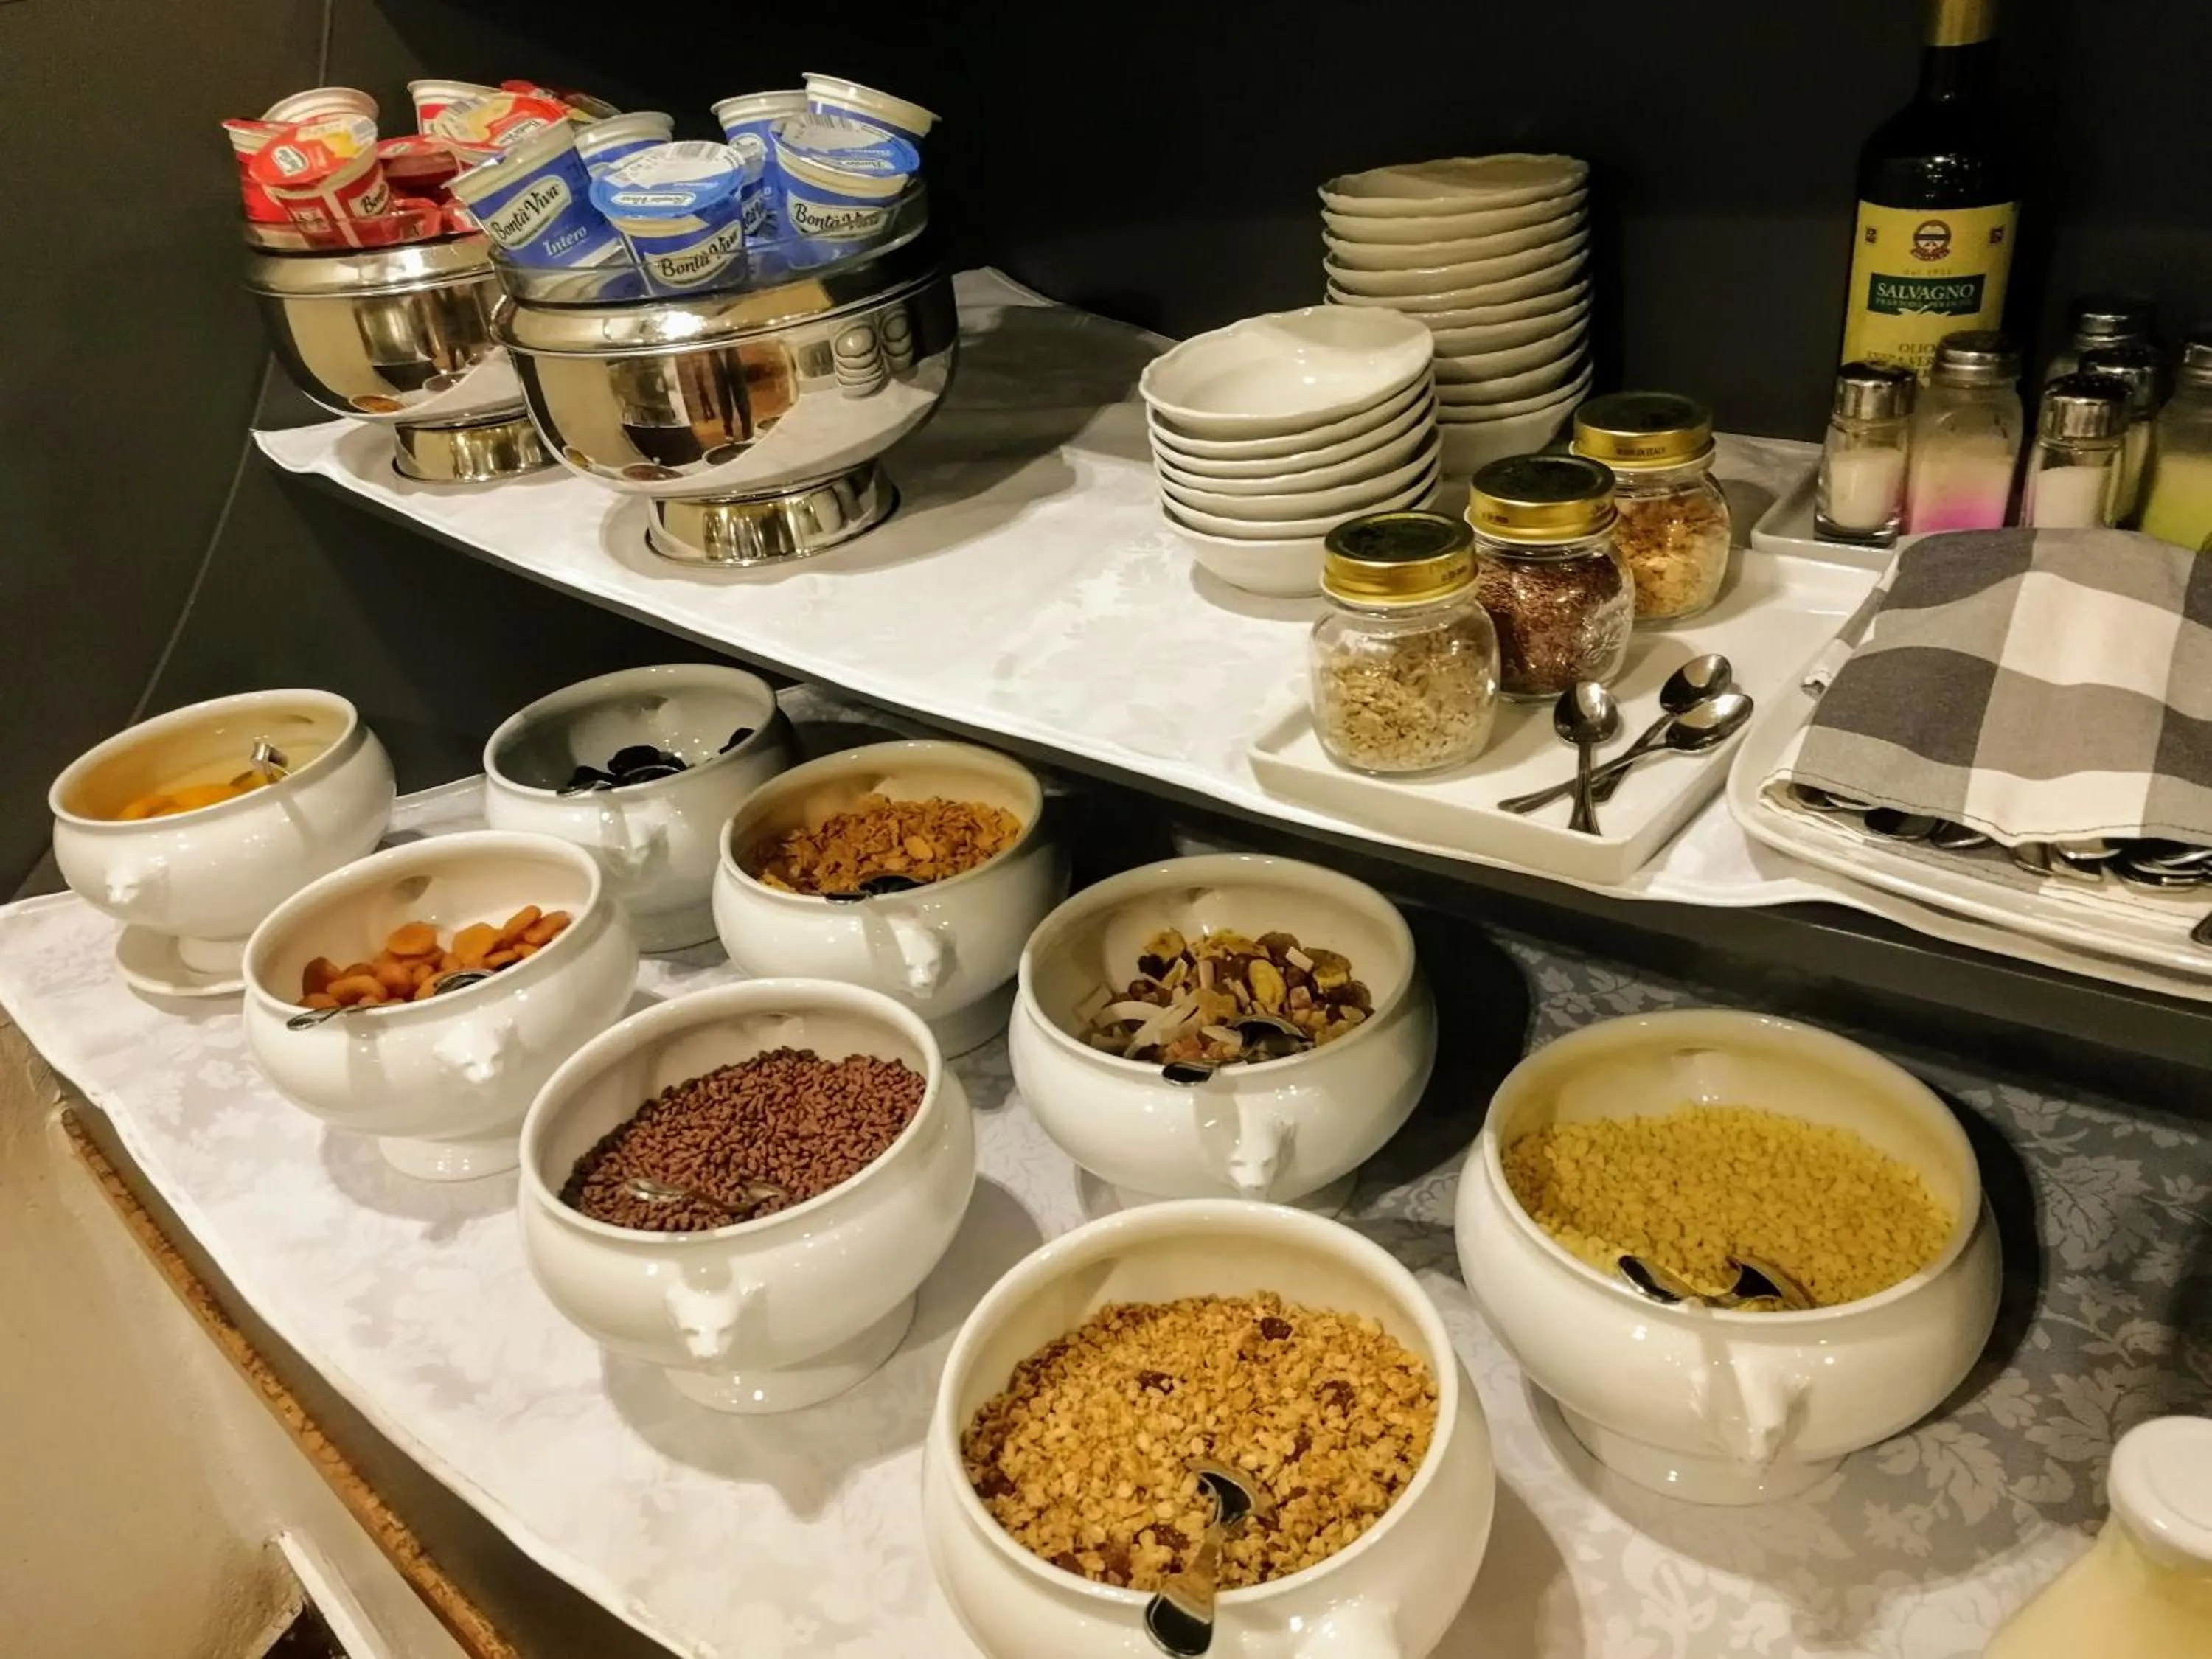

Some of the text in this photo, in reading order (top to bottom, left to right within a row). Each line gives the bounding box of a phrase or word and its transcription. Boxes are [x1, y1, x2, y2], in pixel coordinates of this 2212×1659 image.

[490, 184, 559, 240] Bontà Viva
[794, 203, 840, 231] Bontà
[543, 226, 587, 256] Intero
[660, 251, 710, 277] Bontà
[1877, 282, 1975, 300] SALVAGNO
[1899, 343, 1935, 354] OLIO
